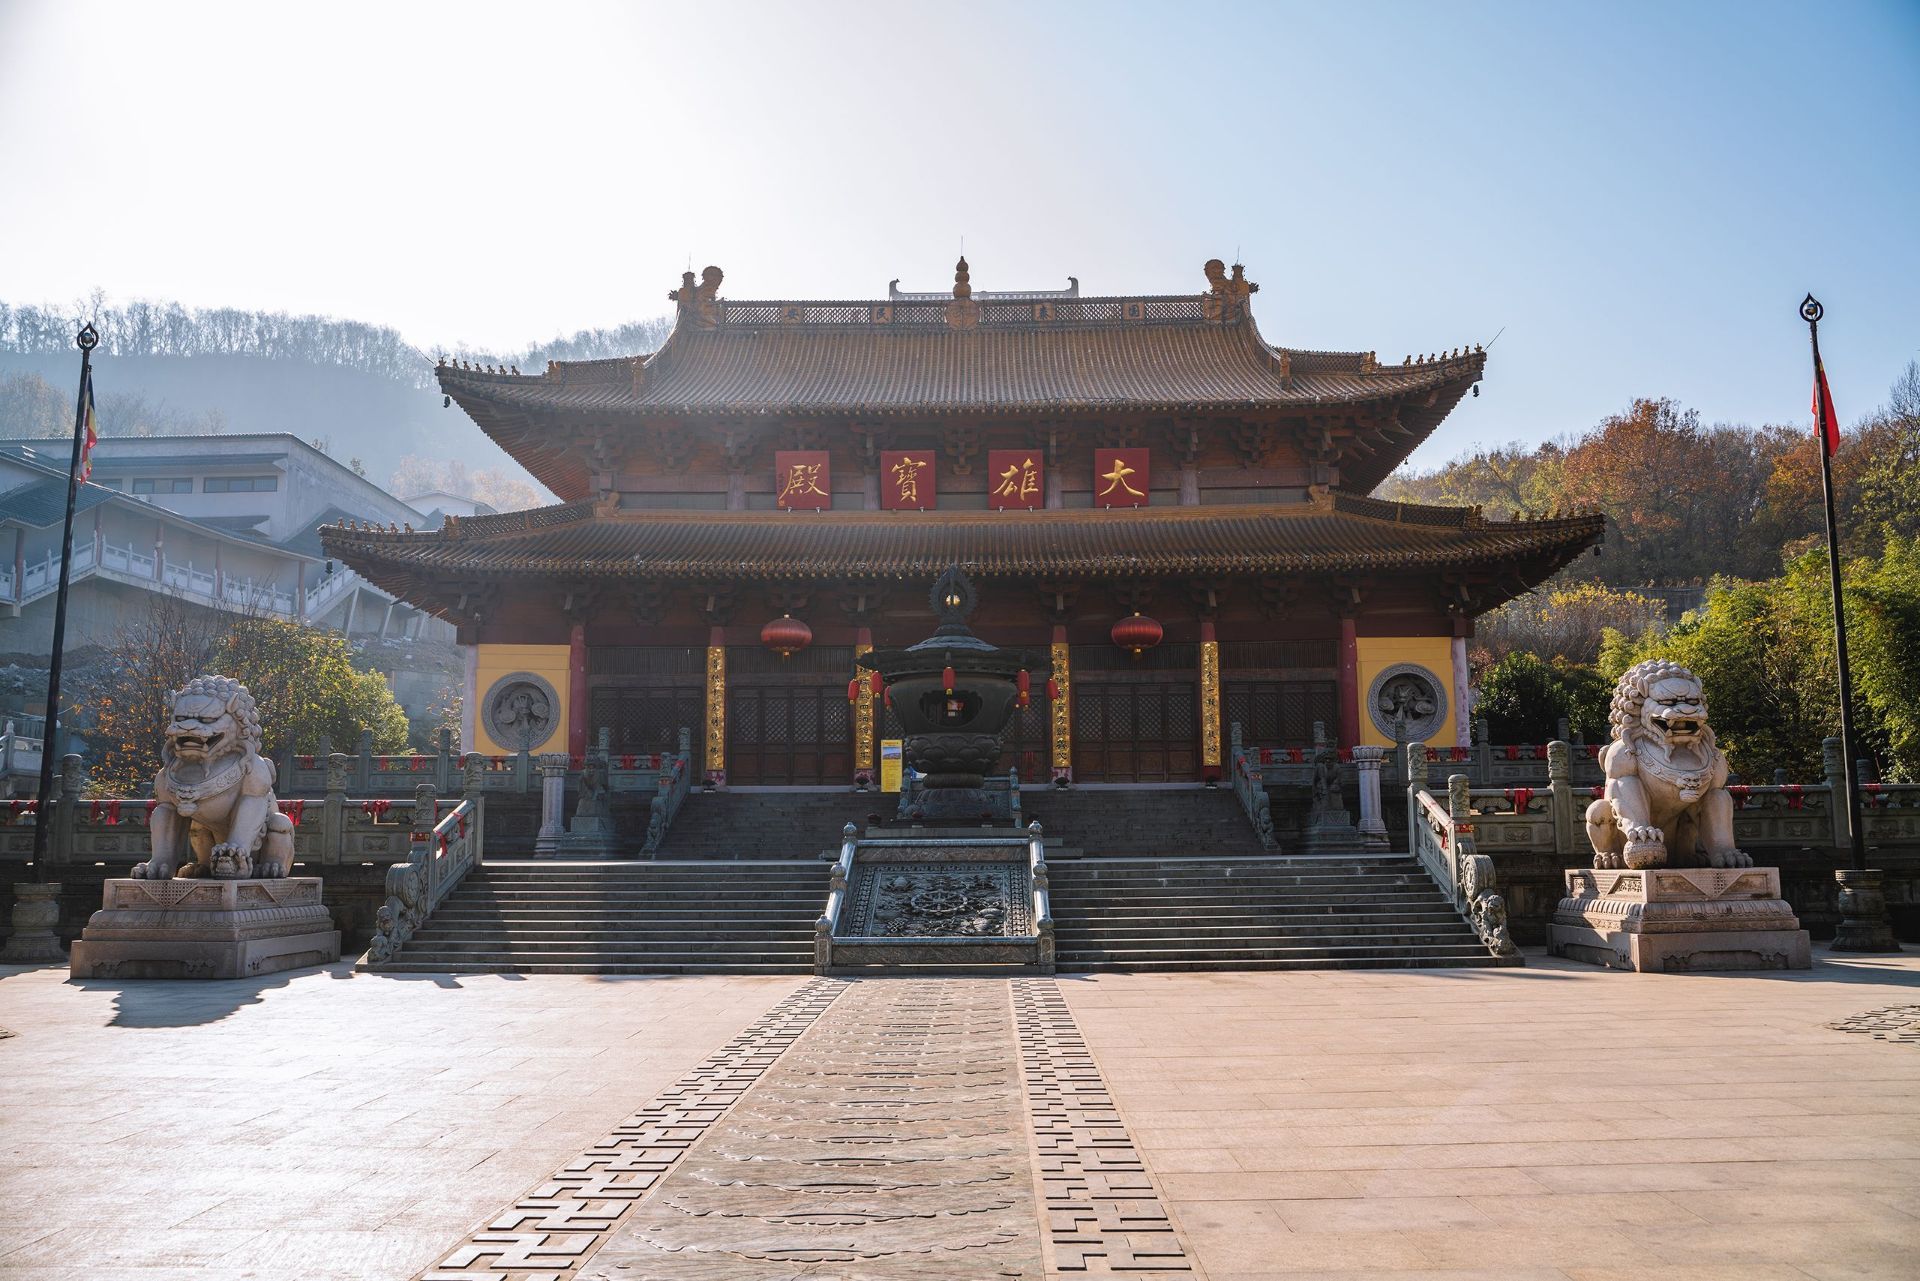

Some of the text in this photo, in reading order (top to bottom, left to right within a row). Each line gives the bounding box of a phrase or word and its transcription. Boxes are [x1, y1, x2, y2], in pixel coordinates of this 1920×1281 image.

[778, 463, 829, 500] 殿
[992, 458, 1039, 501] 雄
[1099, 459, 1145, 497] 大
